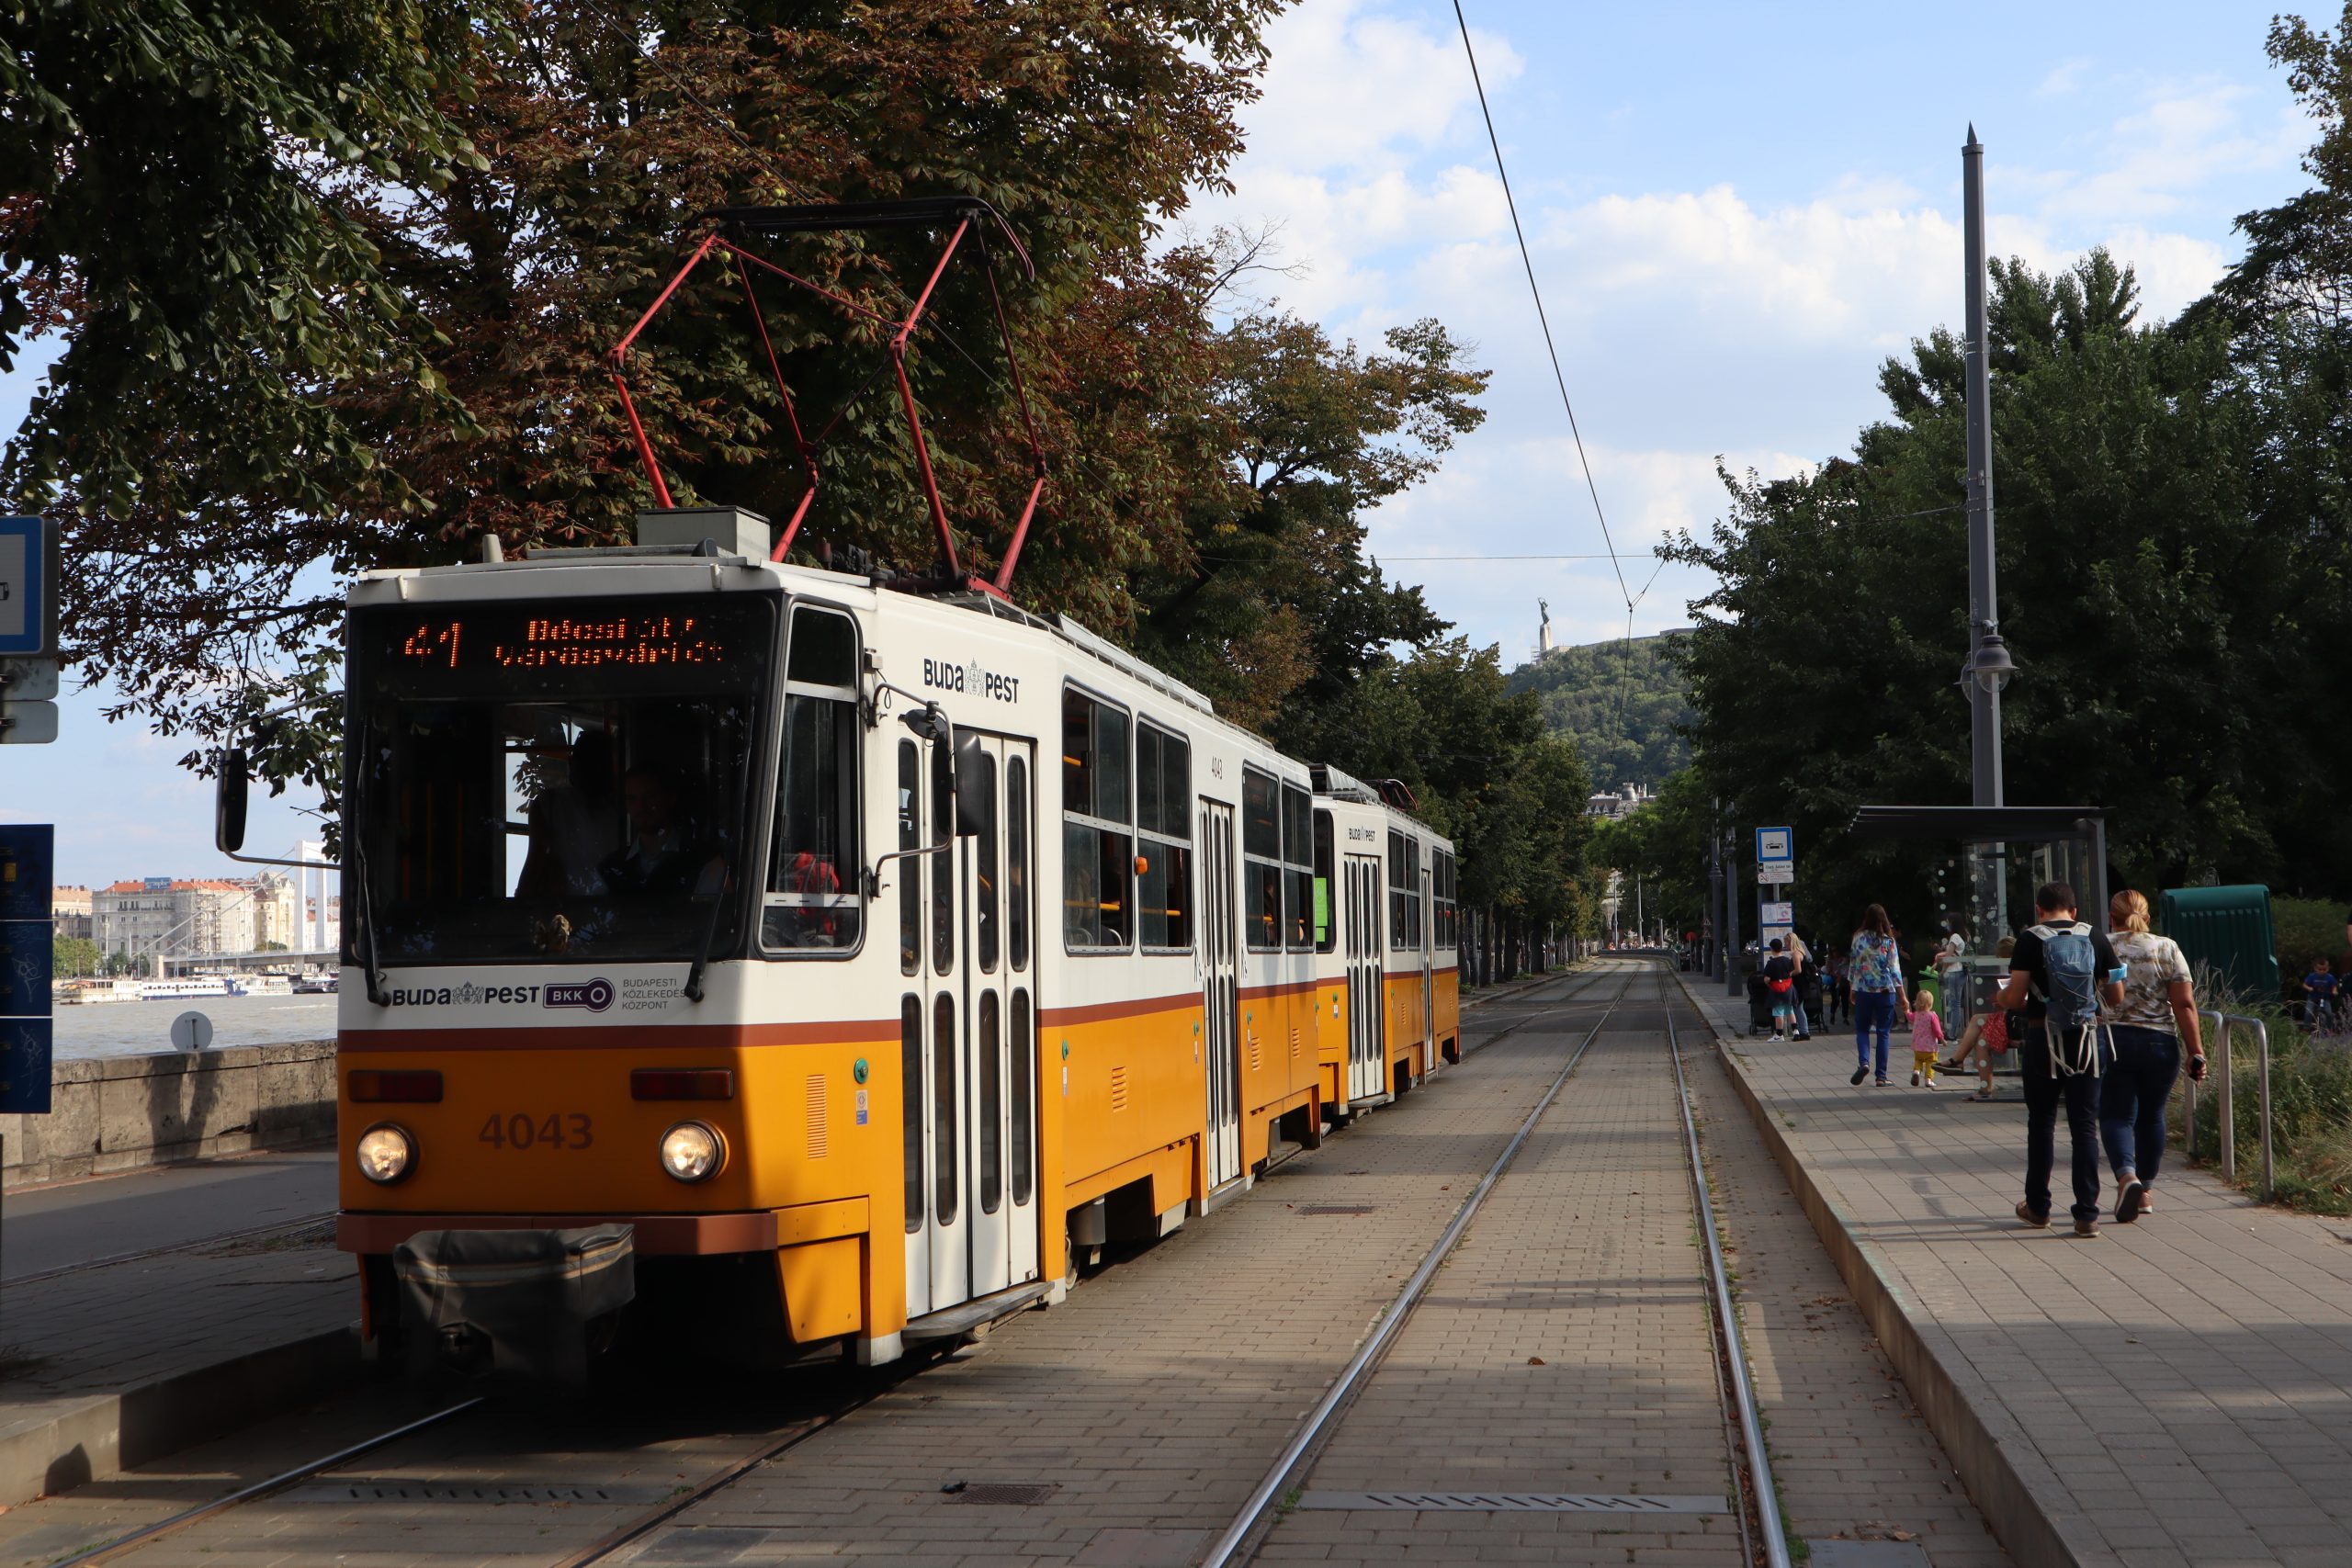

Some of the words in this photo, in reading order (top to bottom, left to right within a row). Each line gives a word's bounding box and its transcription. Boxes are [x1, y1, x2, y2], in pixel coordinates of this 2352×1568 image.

[404, 622, 460, 669] 41
[1211, 756, 1223, 780] 4043
[622, 978, 677, 988] BUDAPESTI
[552, 989, 583, 1002] BKK
[621, 1000, 669, 1010] KÖZPONT
[478, 1112, 594, 1150] 4043
